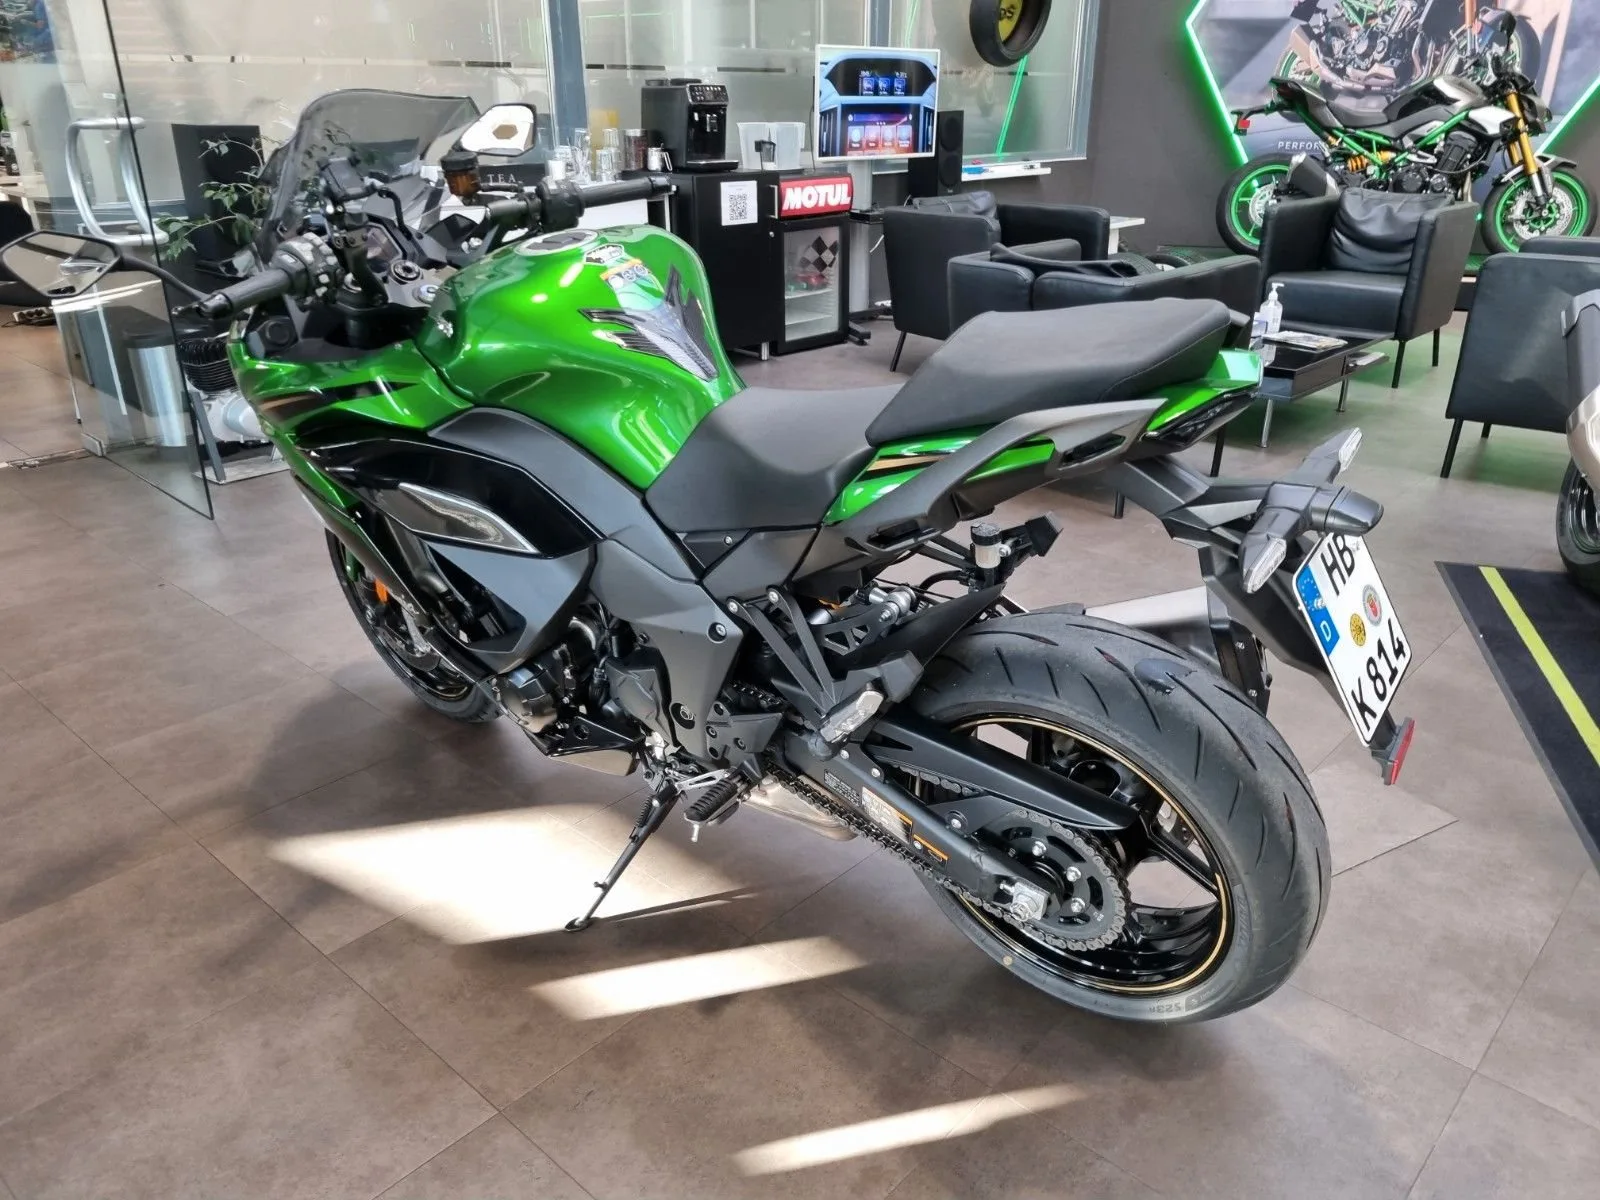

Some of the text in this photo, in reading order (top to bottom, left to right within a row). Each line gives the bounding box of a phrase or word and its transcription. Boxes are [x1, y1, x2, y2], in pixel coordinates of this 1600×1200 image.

[487, 173, 516, 185] TEA
[782, 183, 852, 210] MOTUL
[1320, 532, 1355, 596] HB
[1320, 622, 1332, 642] D
[1351, 618, 1406, 732] K 814
